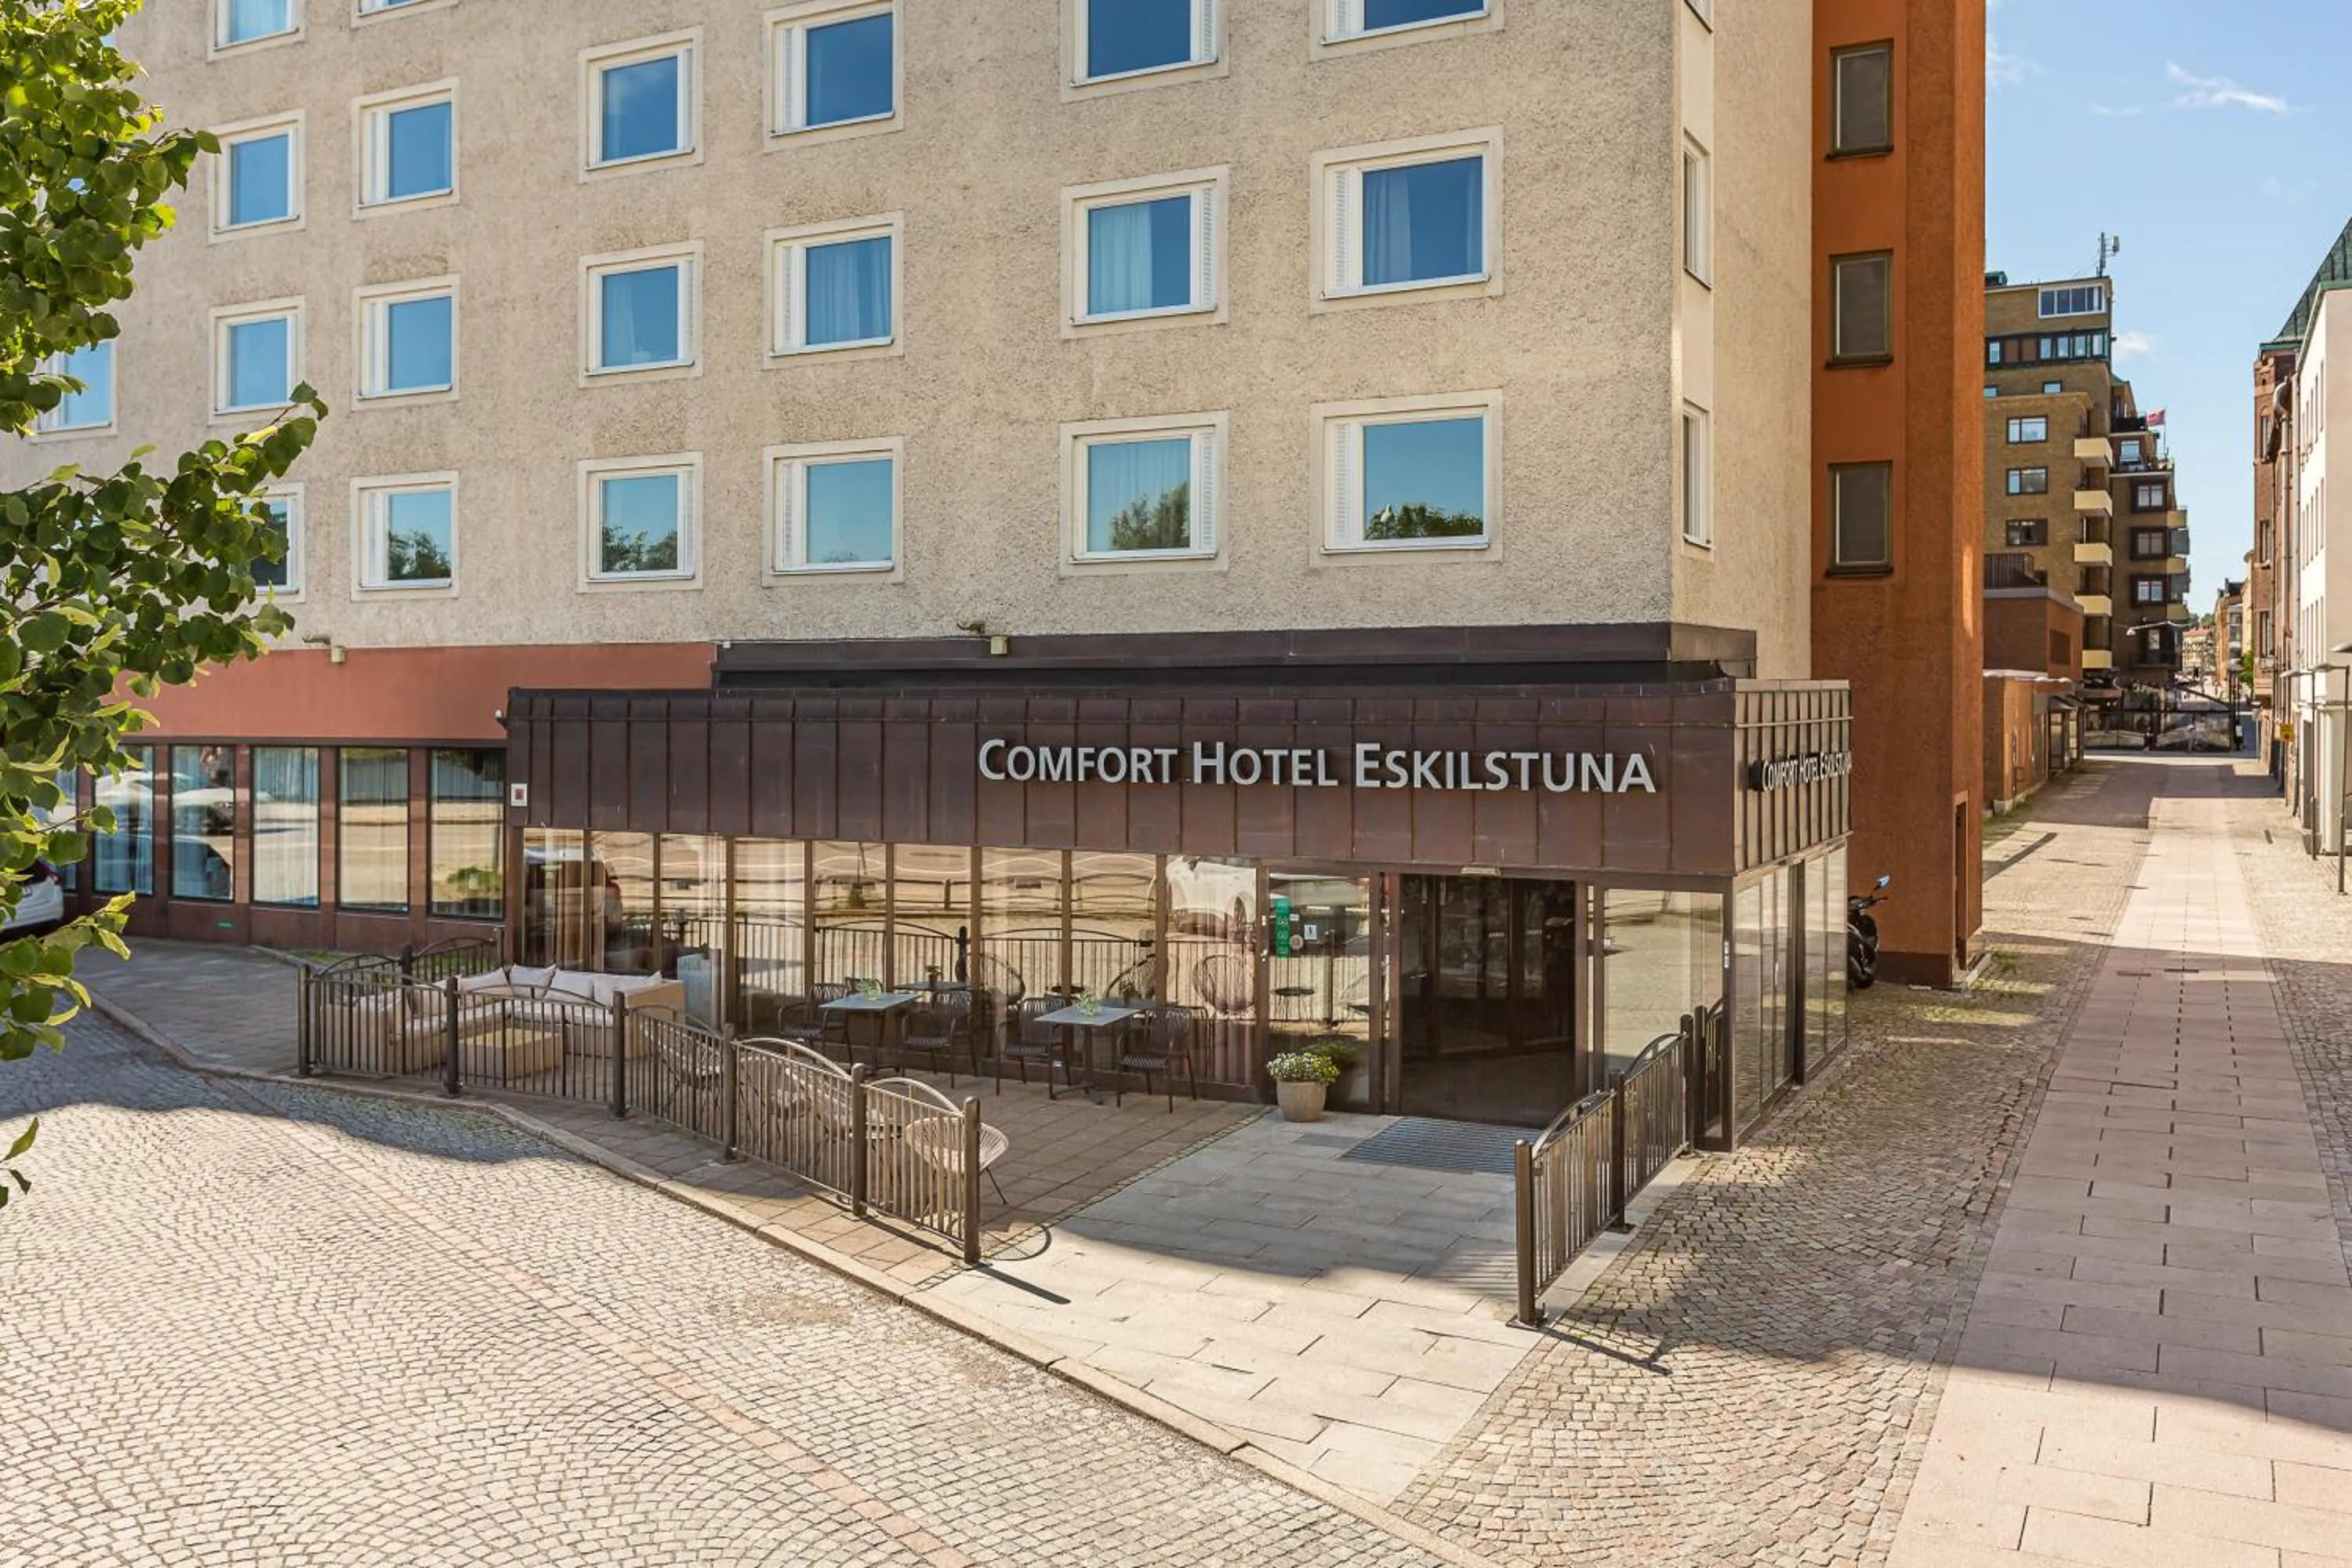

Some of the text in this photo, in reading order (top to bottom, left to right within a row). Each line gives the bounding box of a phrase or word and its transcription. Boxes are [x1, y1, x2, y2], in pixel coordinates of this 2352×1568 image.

[978, 739, 1657, 794] COMFORT HOTEL ESKILSTUNA
[1762, 757, 1798, 792] COMFORT
[1799, 752, 1820, 783] HOTEL
